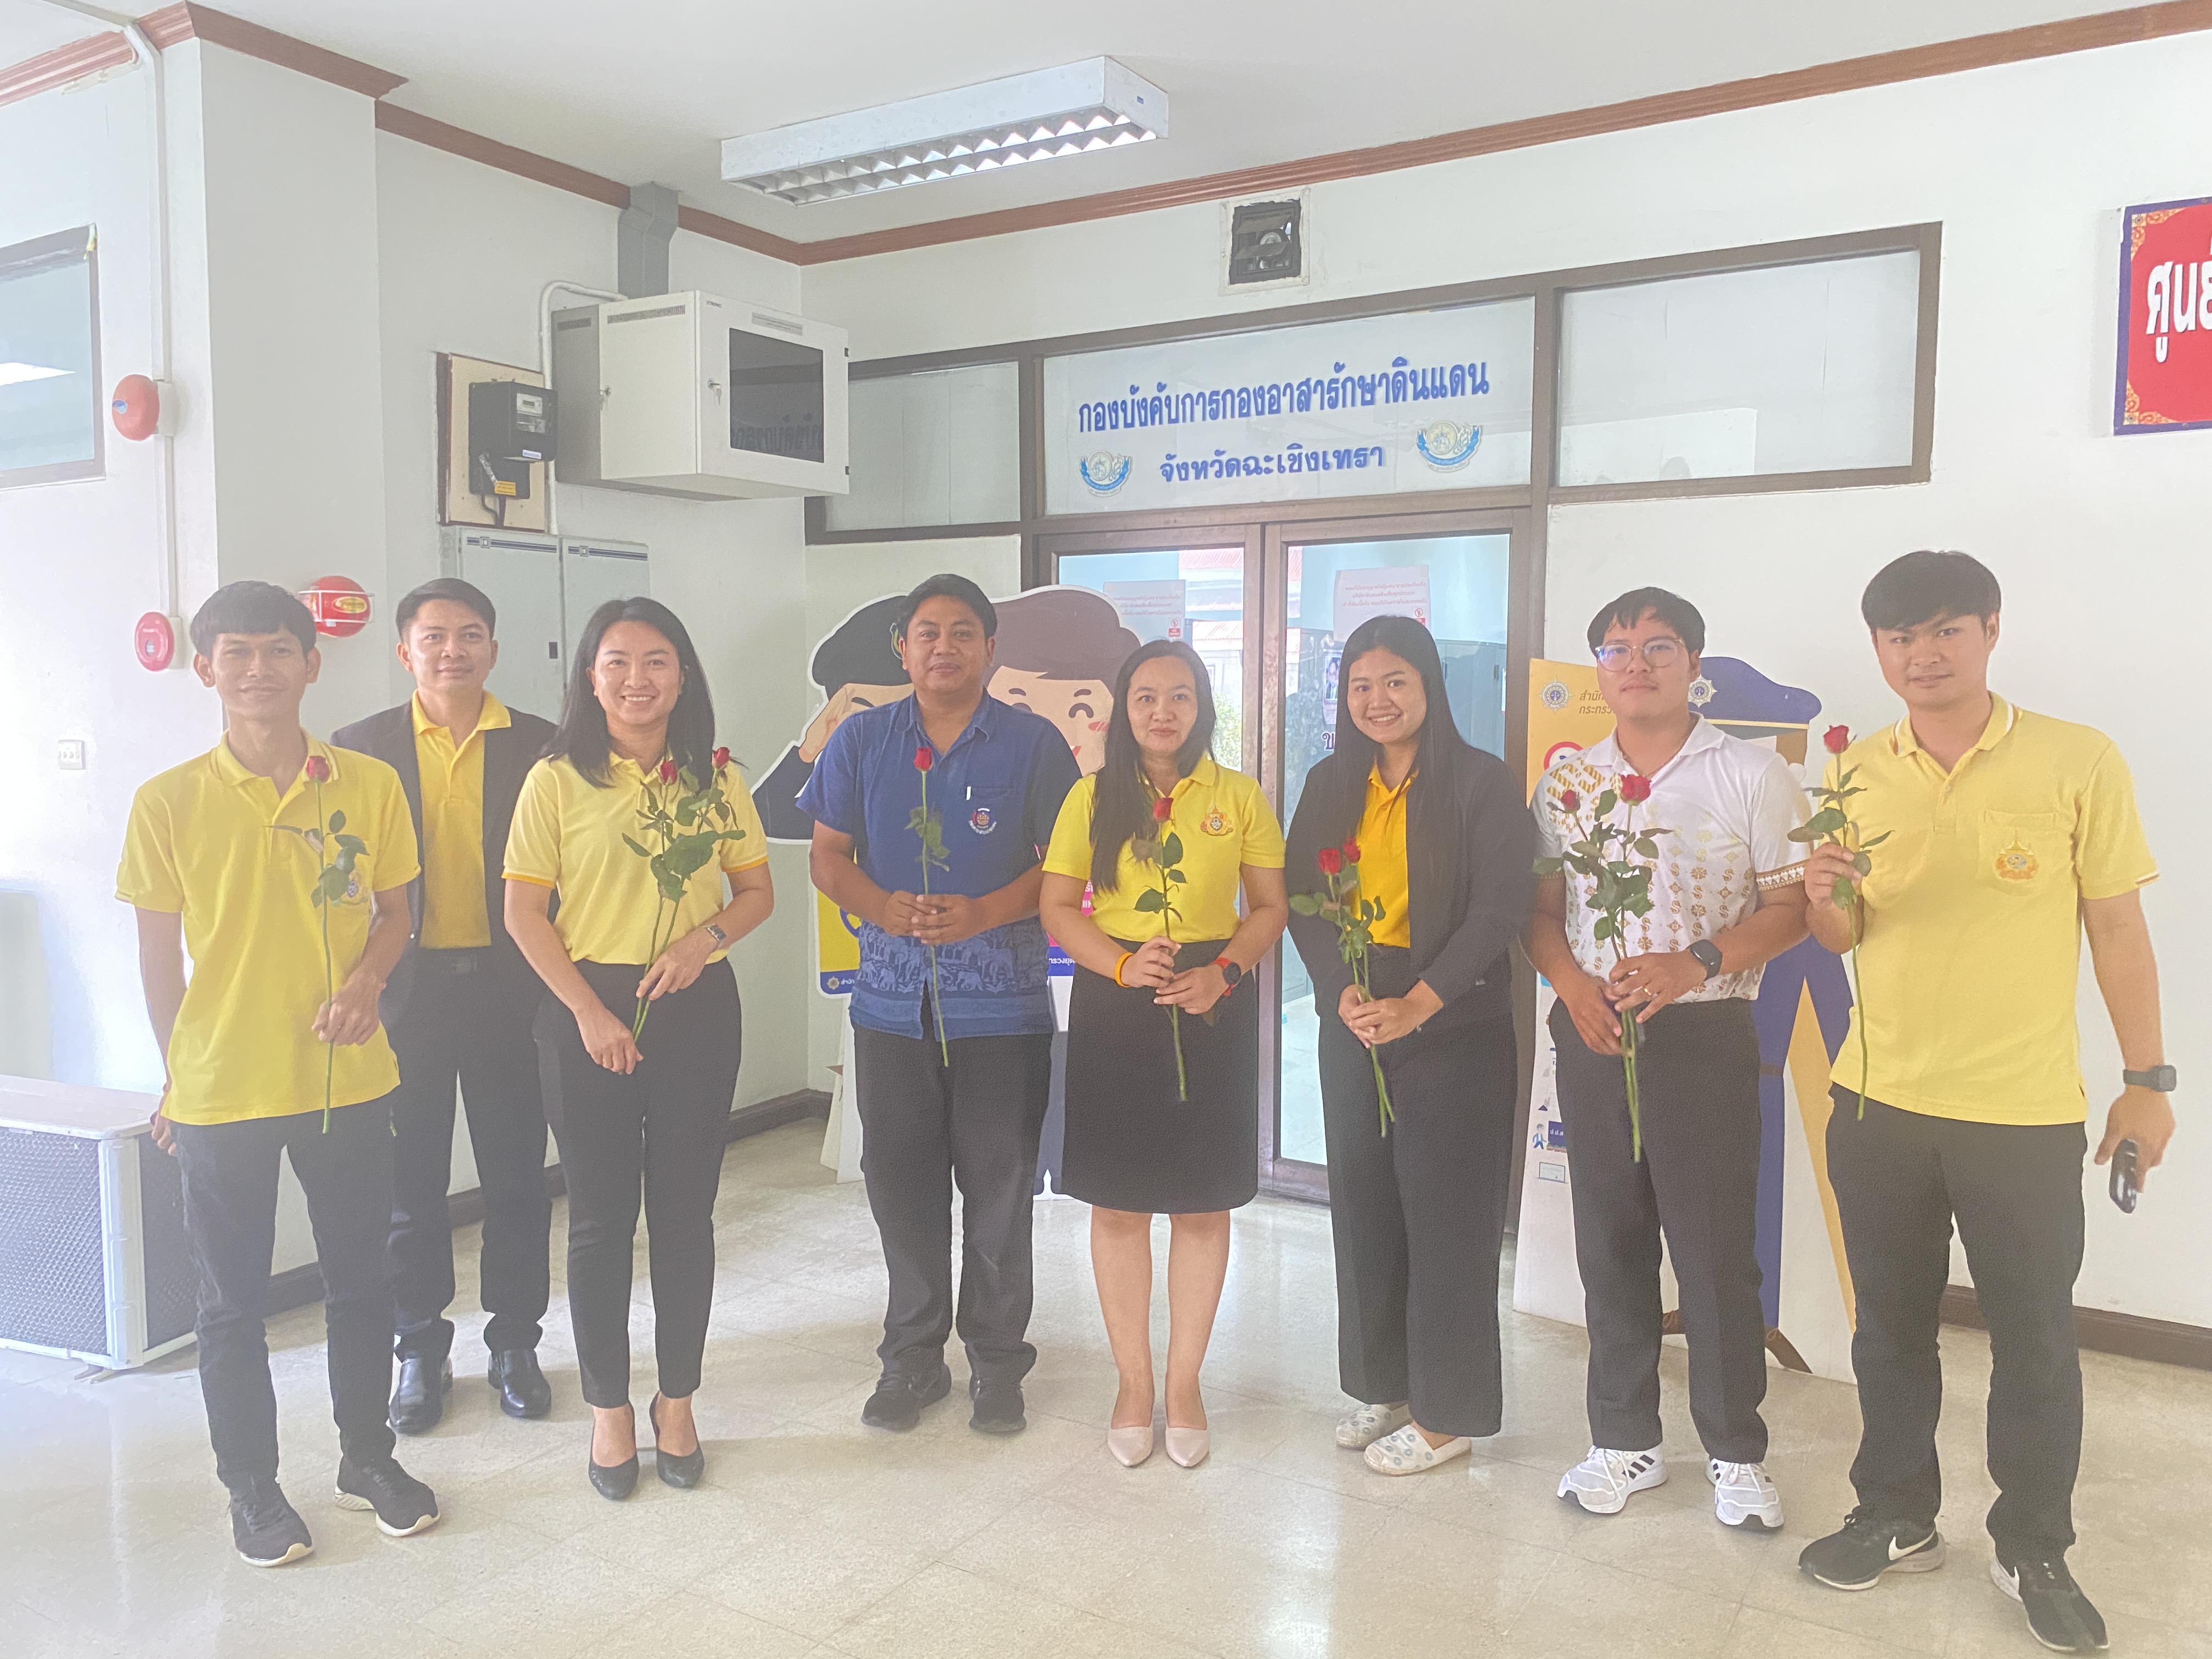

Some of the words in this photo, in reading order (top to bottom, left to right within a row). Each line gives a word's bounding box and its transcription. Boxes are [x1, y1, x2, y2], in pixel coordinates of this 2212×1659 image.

[2146, 237, 2212, 363] ศูนย
[1079, 356, 1490, 433] กองบังคับการกองอาสารักษาดินแดน
[1159, 442, 1384, 483] จังหวัดฉะเชิงเทรา
